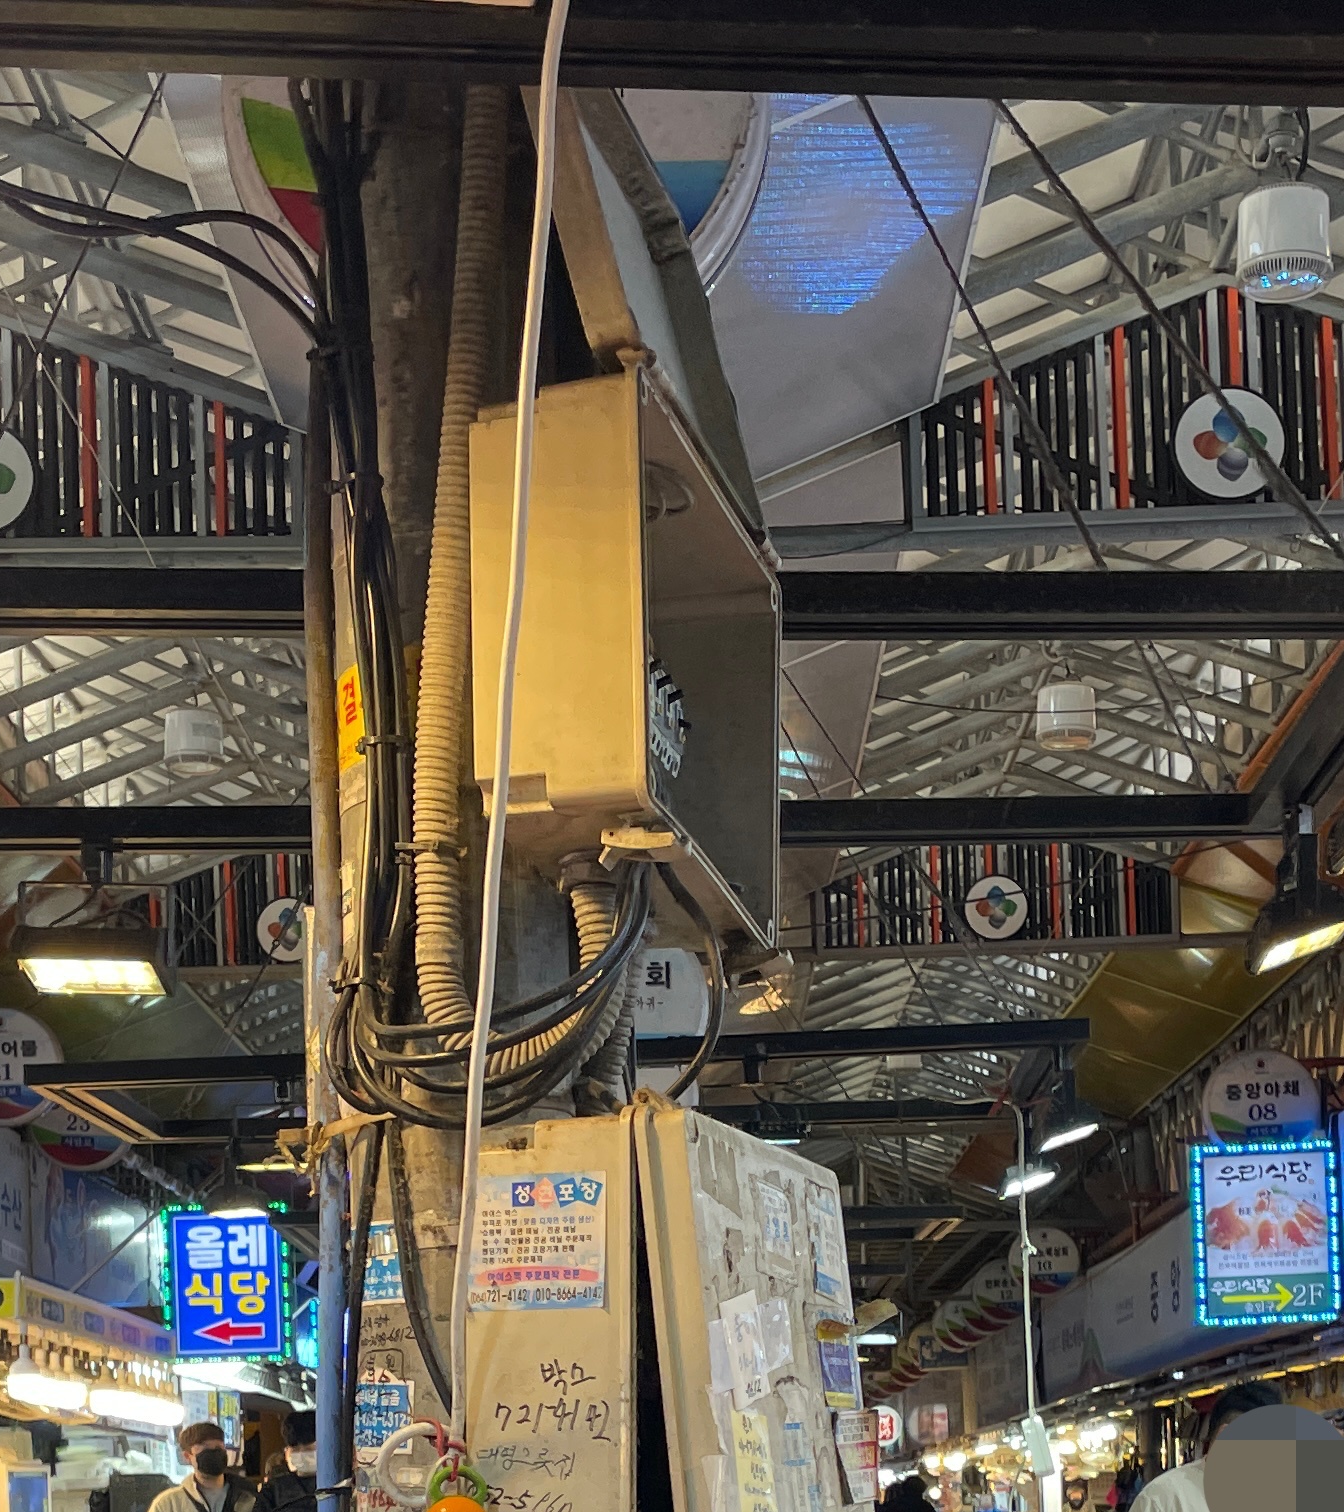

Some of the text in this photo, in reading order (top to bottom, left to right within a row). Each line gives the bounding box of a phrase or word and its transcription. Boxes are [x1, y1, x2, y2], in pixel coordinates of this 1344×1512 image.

[1248, 1102, 1278, 1121] 08
[186, 1226, 267, 1268] 올레
[184, 1272, 271, 1315] 식당
[1292, 1282, 1325, 1307] 2F
